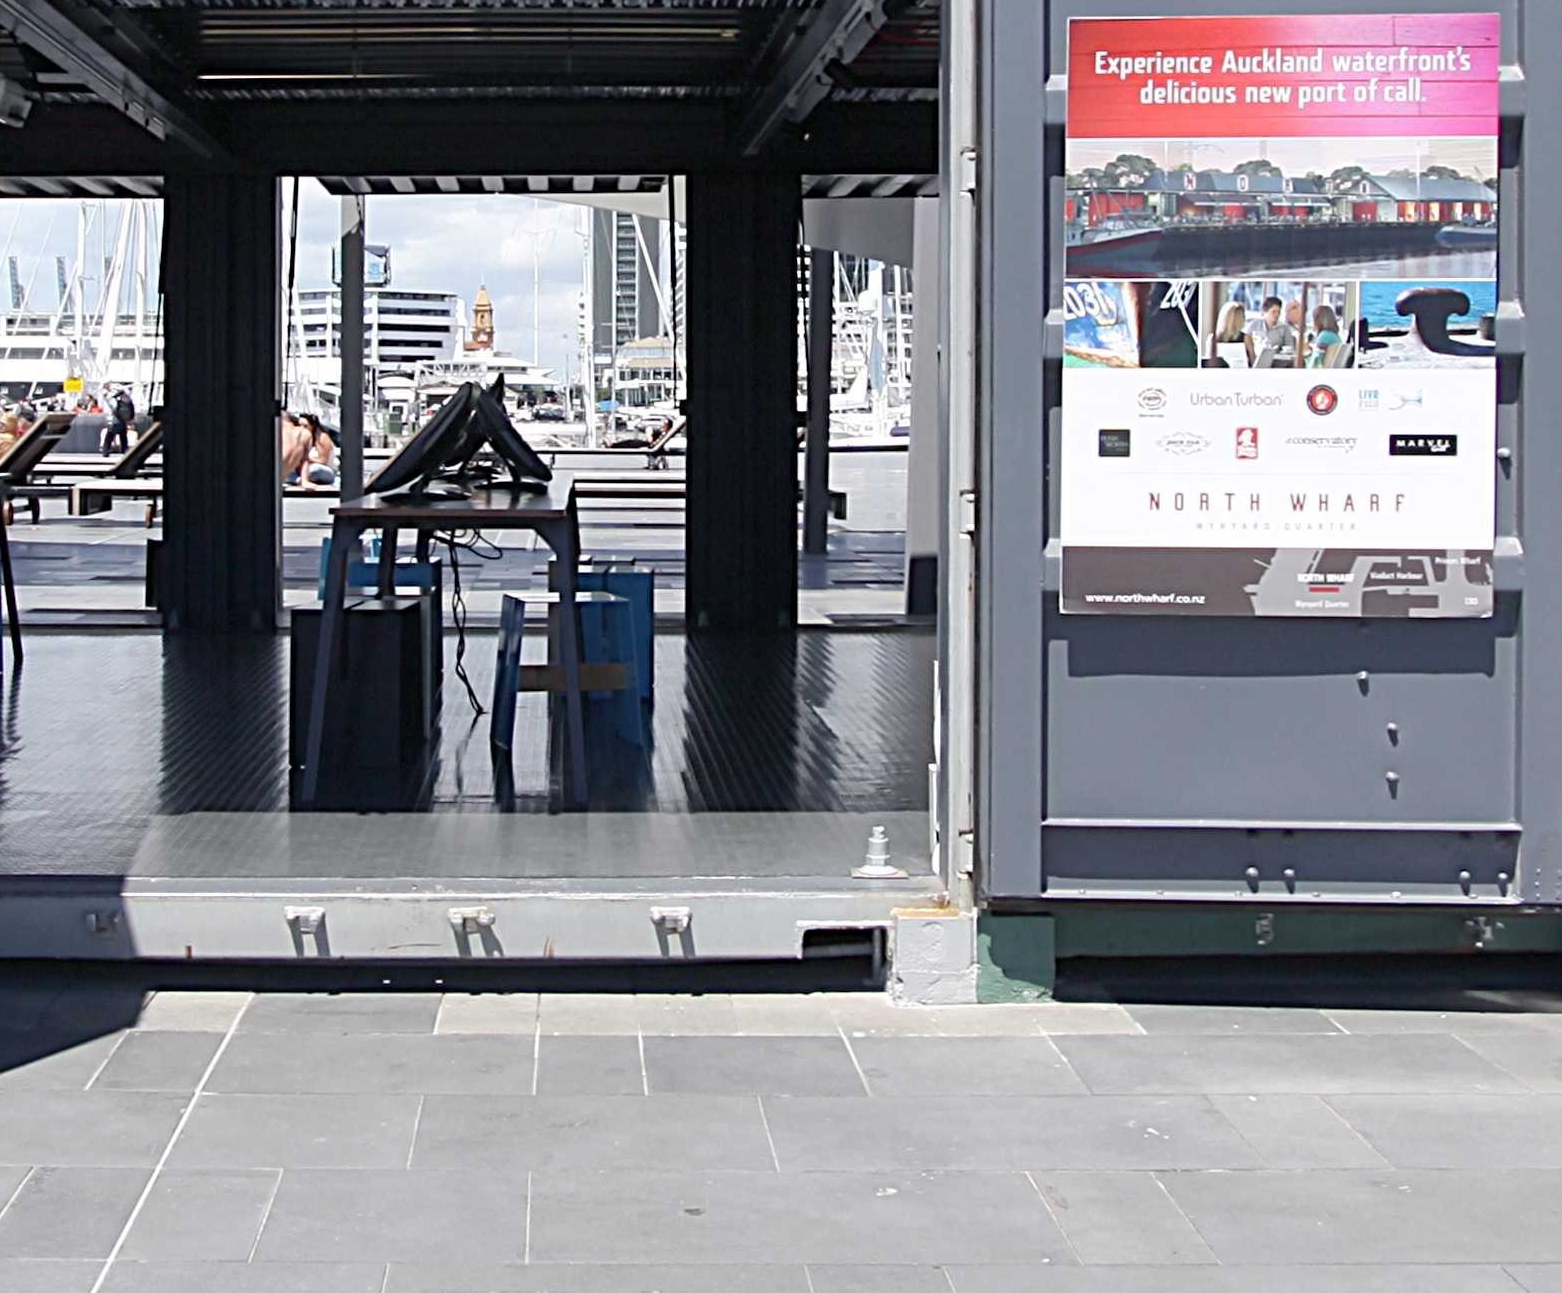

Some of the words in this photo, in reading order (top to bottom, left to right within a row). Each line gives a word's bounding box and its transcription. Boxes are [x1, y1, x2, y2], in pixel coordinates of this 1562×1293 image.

[1095, 51, 1213, 80] Experience
[1221, 48, 1324, 74] Auckland
[1332, 46, 1471, 73] waterfront's
[1140, 79, 1237, 106] delicious
[1245, 86, 1291, 104] new
[1298, 82, 1347, 109] port
[1353, 78, 1379, 103] of
[1383, 77, 1427, 103] call.
[1189, 393, 1233, 406] Urban
[1235, 392, 1283, 406] Turban
[1149, 492, 1260, 511] NORTH
[1290, 494, 1405, 512] WHARF
[1284, 523, 1356, 532] QUARTER
[1085, 593, 1206, 605] www.northwharf.co.nz
